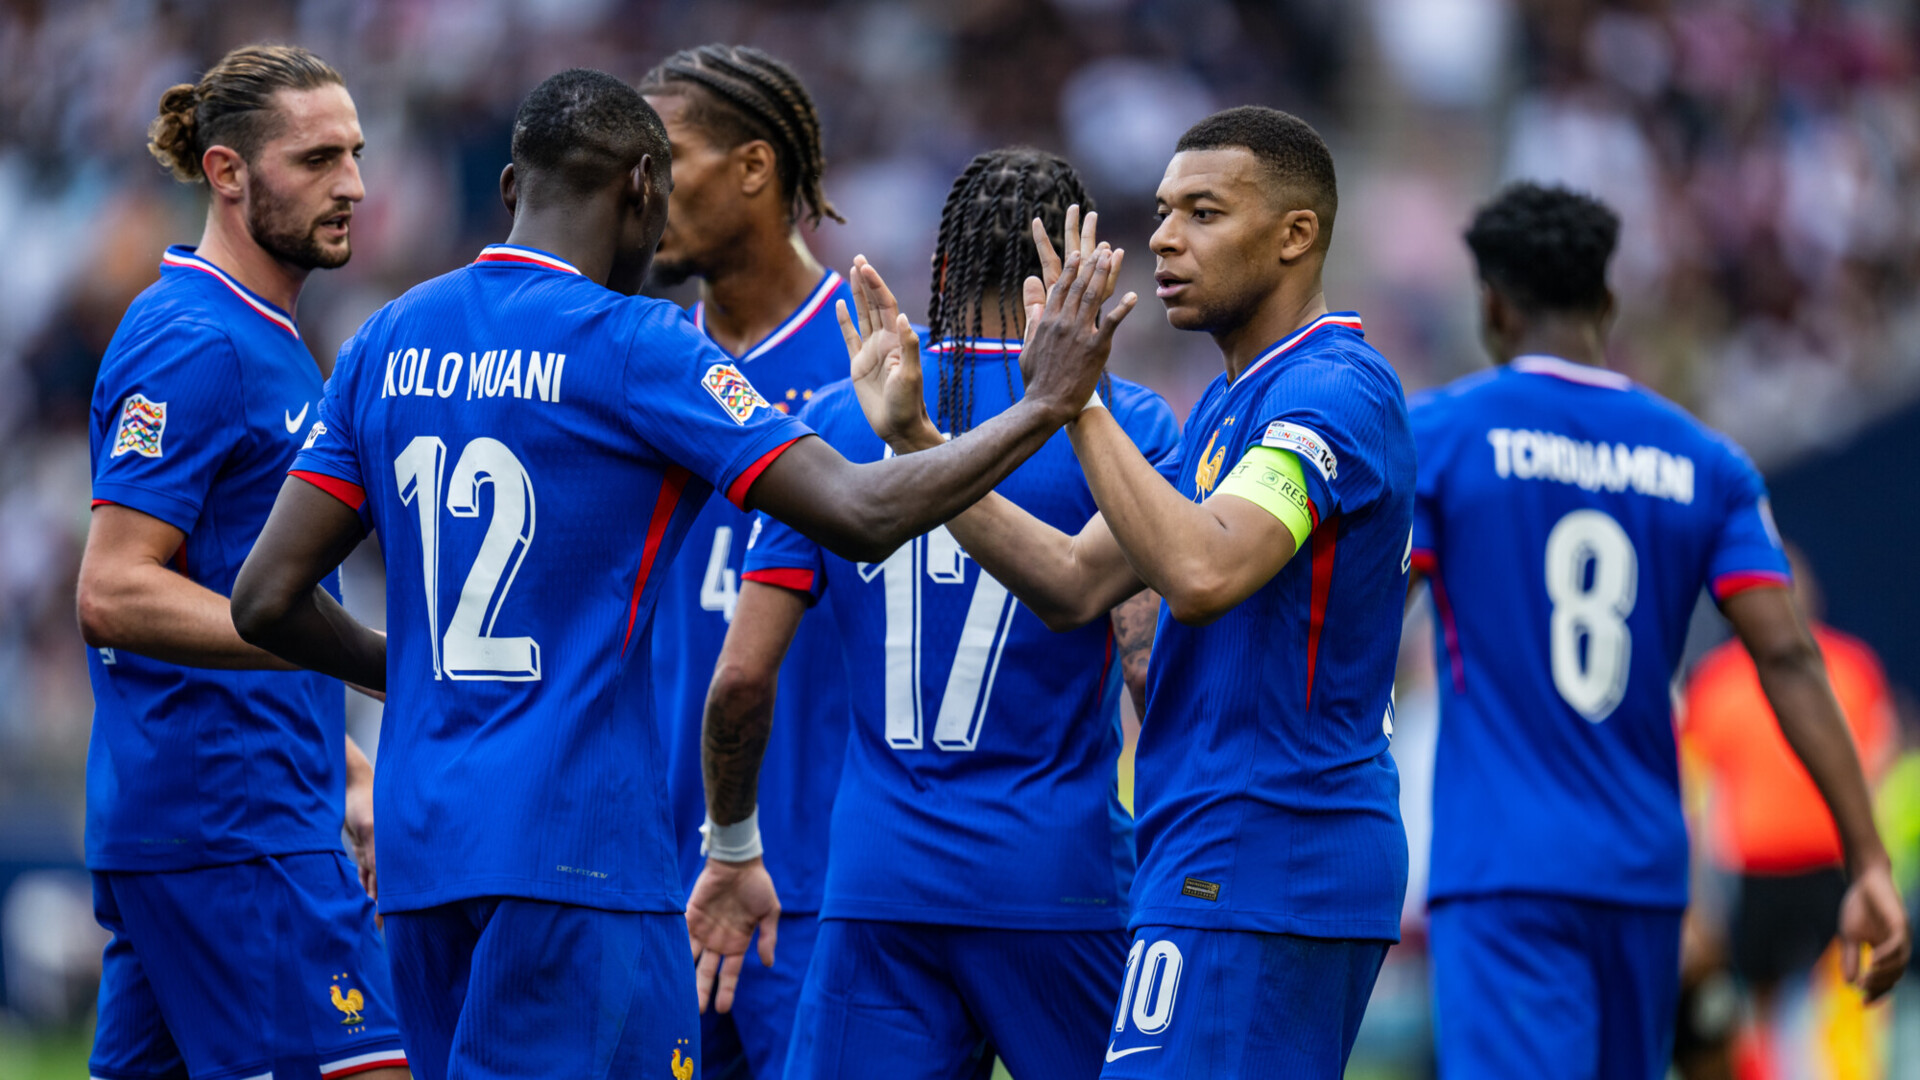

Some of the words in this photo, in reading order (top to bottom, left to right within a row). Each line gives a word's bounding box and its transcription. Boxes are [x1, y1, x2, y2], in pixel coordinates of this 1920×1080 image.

[381, 348, 464, 399] KOLO
[466, 349, 567, 403] MUANI
[1266, 428, 1320, 454] FOUNDATION
[394, 436, 541, 682] 12
[700, 526, 739, 624] 4
[857, 524, 1019, 751] 17
[1545, 508, 1639, 724] 8
[1115, 939, 1183, 1035] 10
